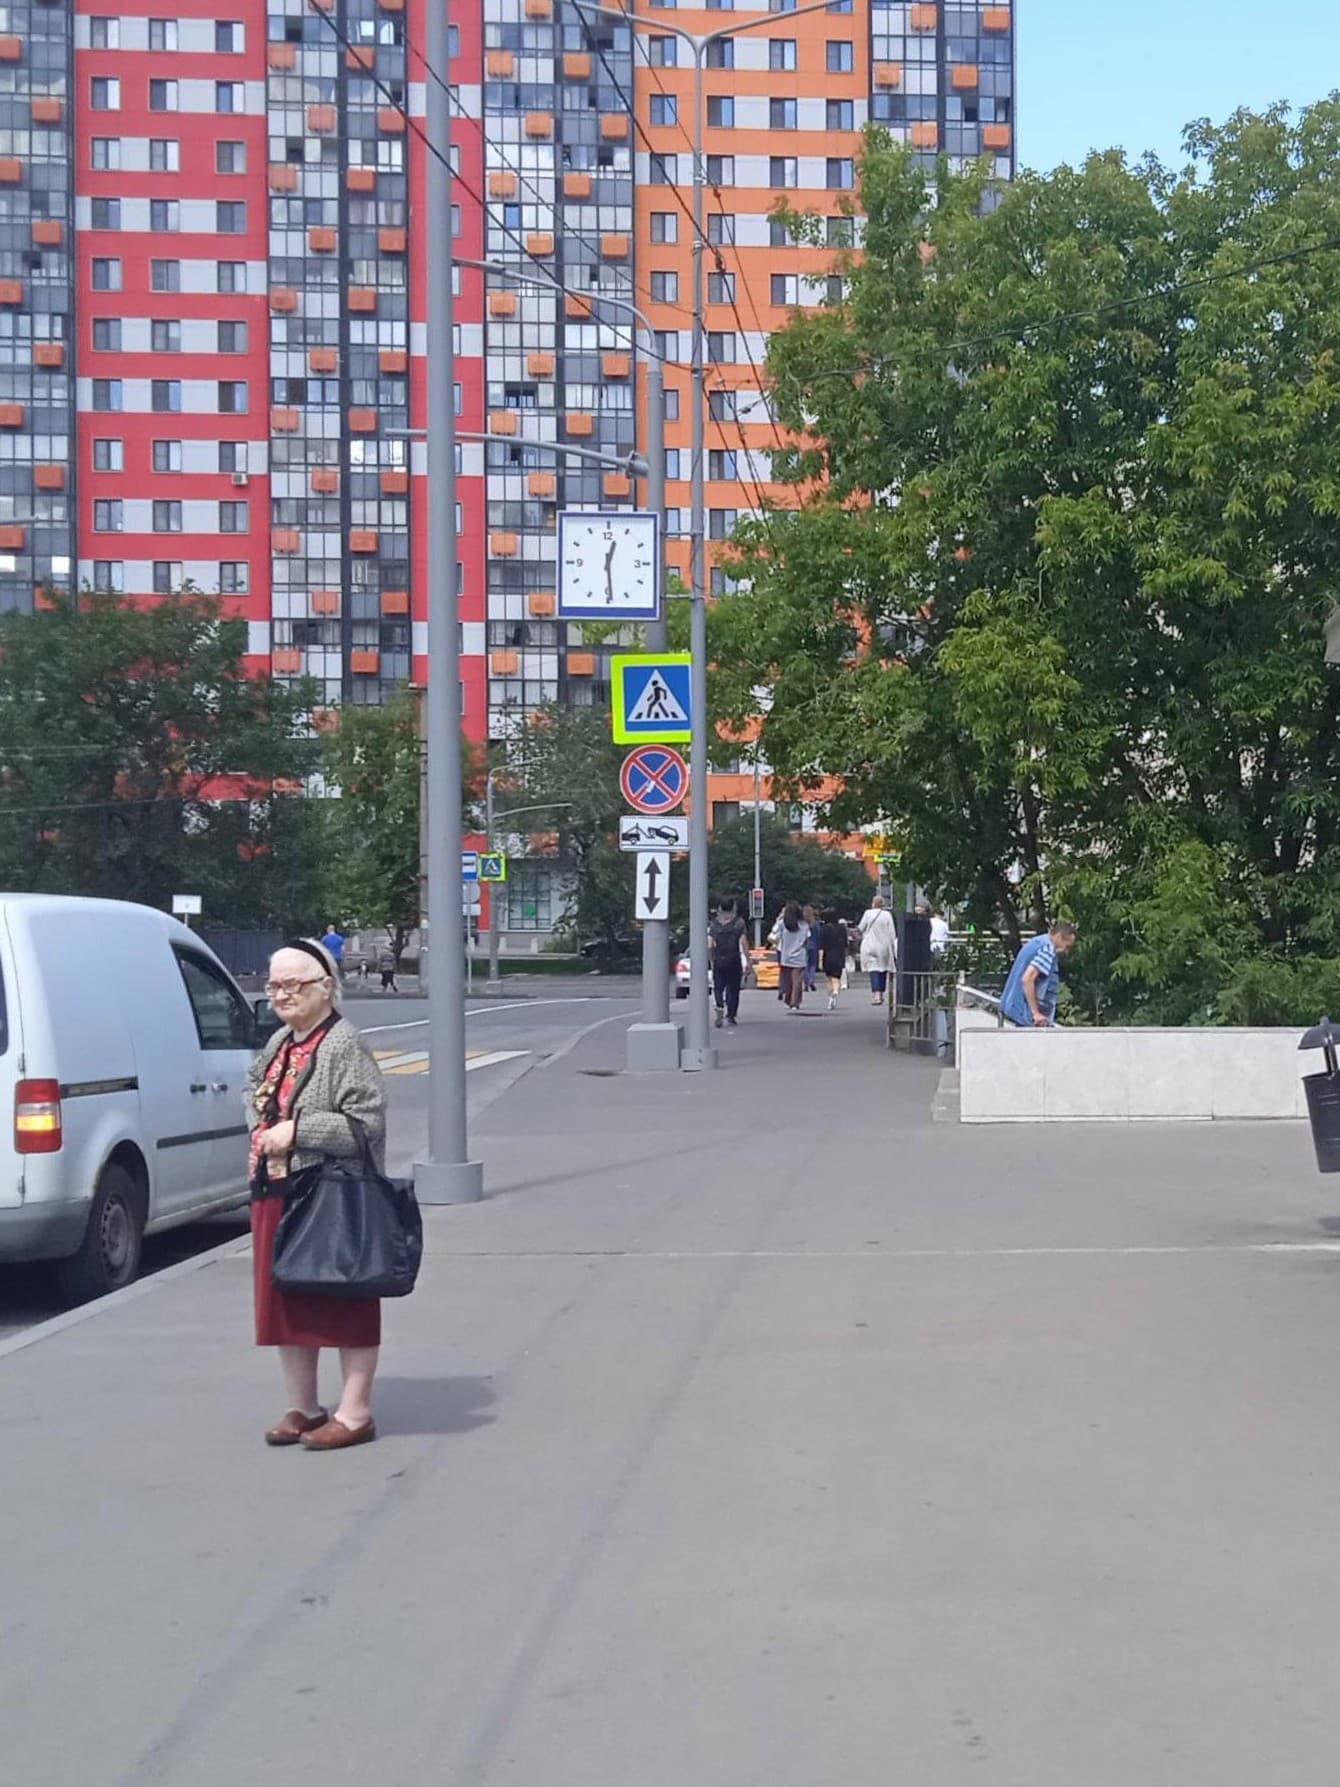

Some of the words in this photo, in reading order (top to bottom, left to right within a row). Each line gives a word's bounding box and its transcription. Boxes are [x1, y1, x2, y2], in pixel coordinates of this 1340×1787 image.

[603, 531, 613, 540] 12
[576, 558, 583, 567] 9
[634, 560, 641, 568] 3
